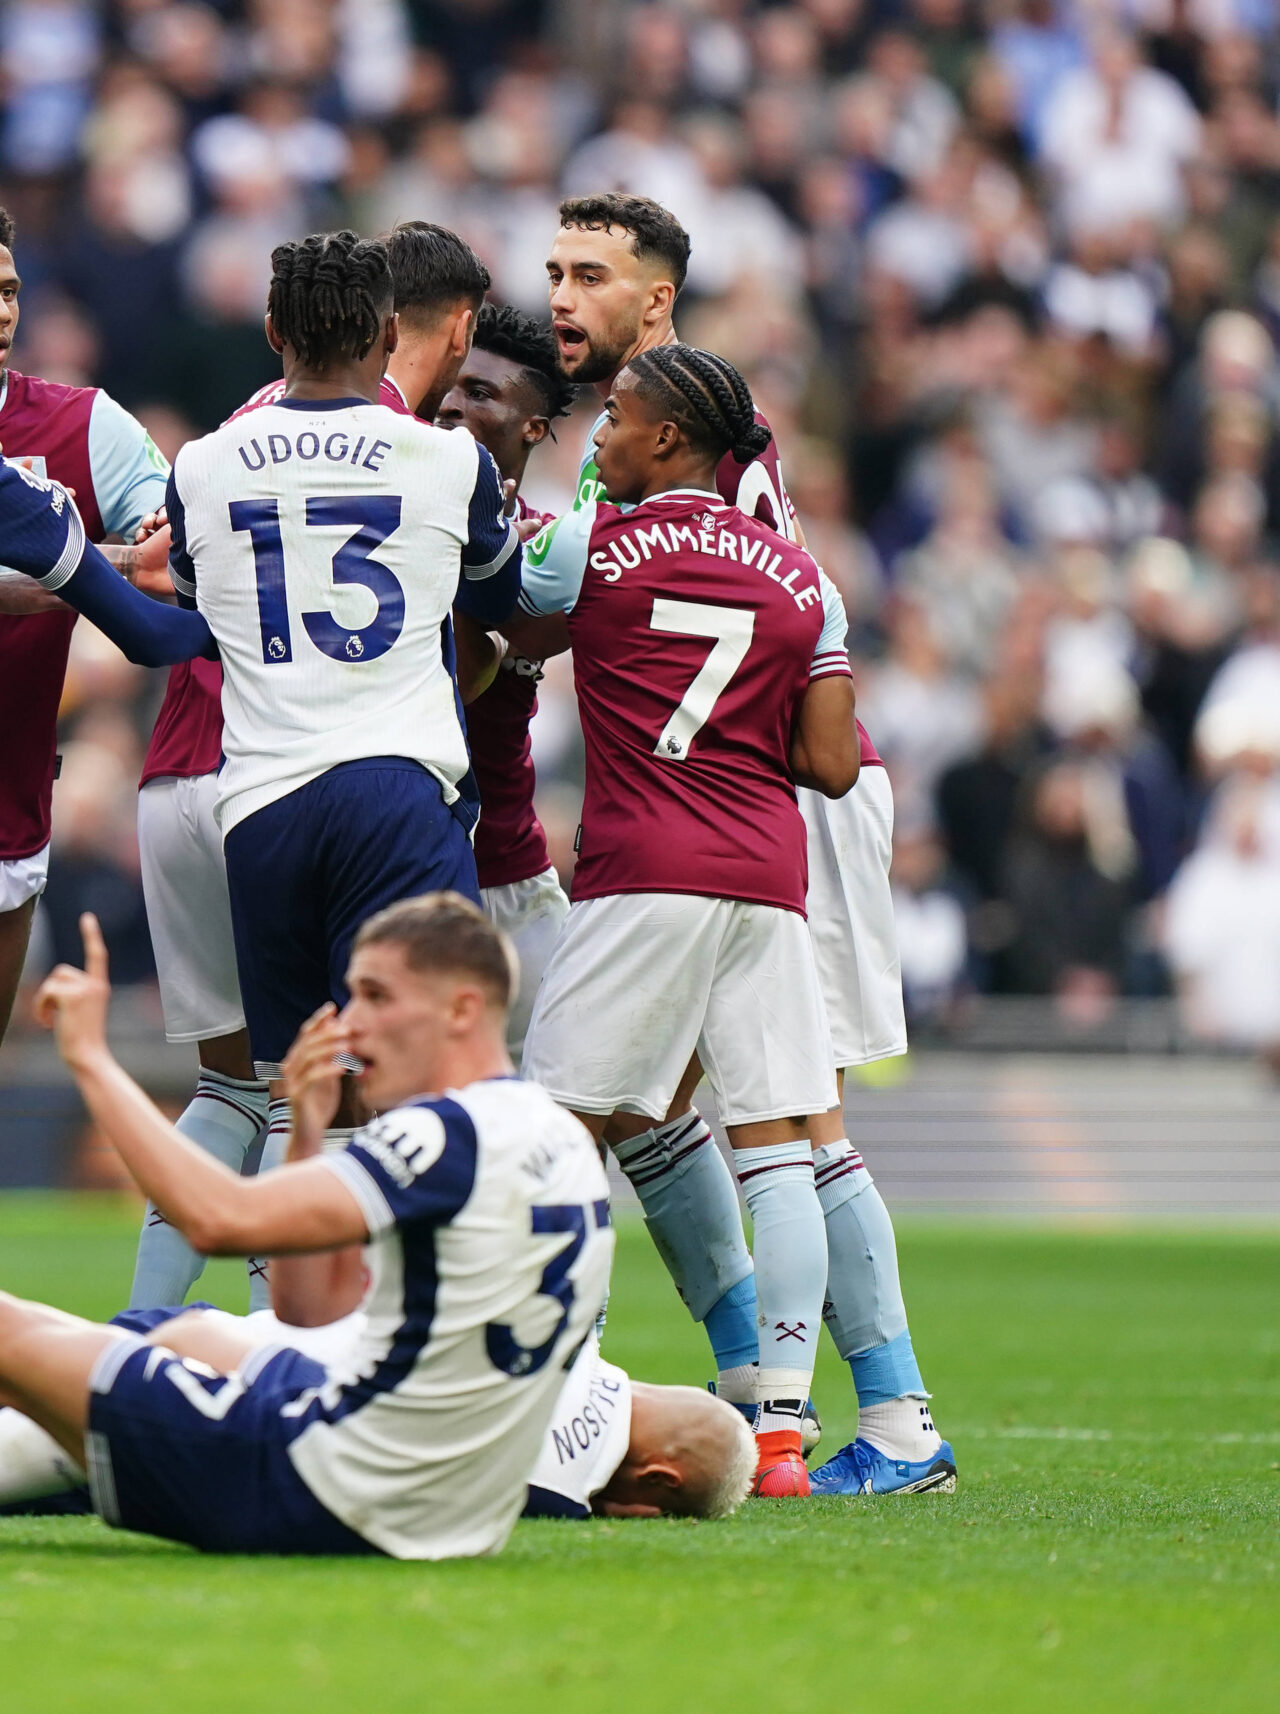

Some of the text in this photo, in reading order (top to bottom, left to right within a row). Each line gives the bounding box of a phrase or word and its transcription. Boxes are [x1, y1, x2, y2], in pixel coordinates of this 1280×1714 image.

[237, 431, 393, 472] UDOGIE
[228, 495, 406, 664] 13
[589, 522, 821, 612] SUMMERVILLE
[650, 597, 756, 761] 7
[486, 1198, 610, 1378] 3
[551, 1376, 620, 1465] RLISON
